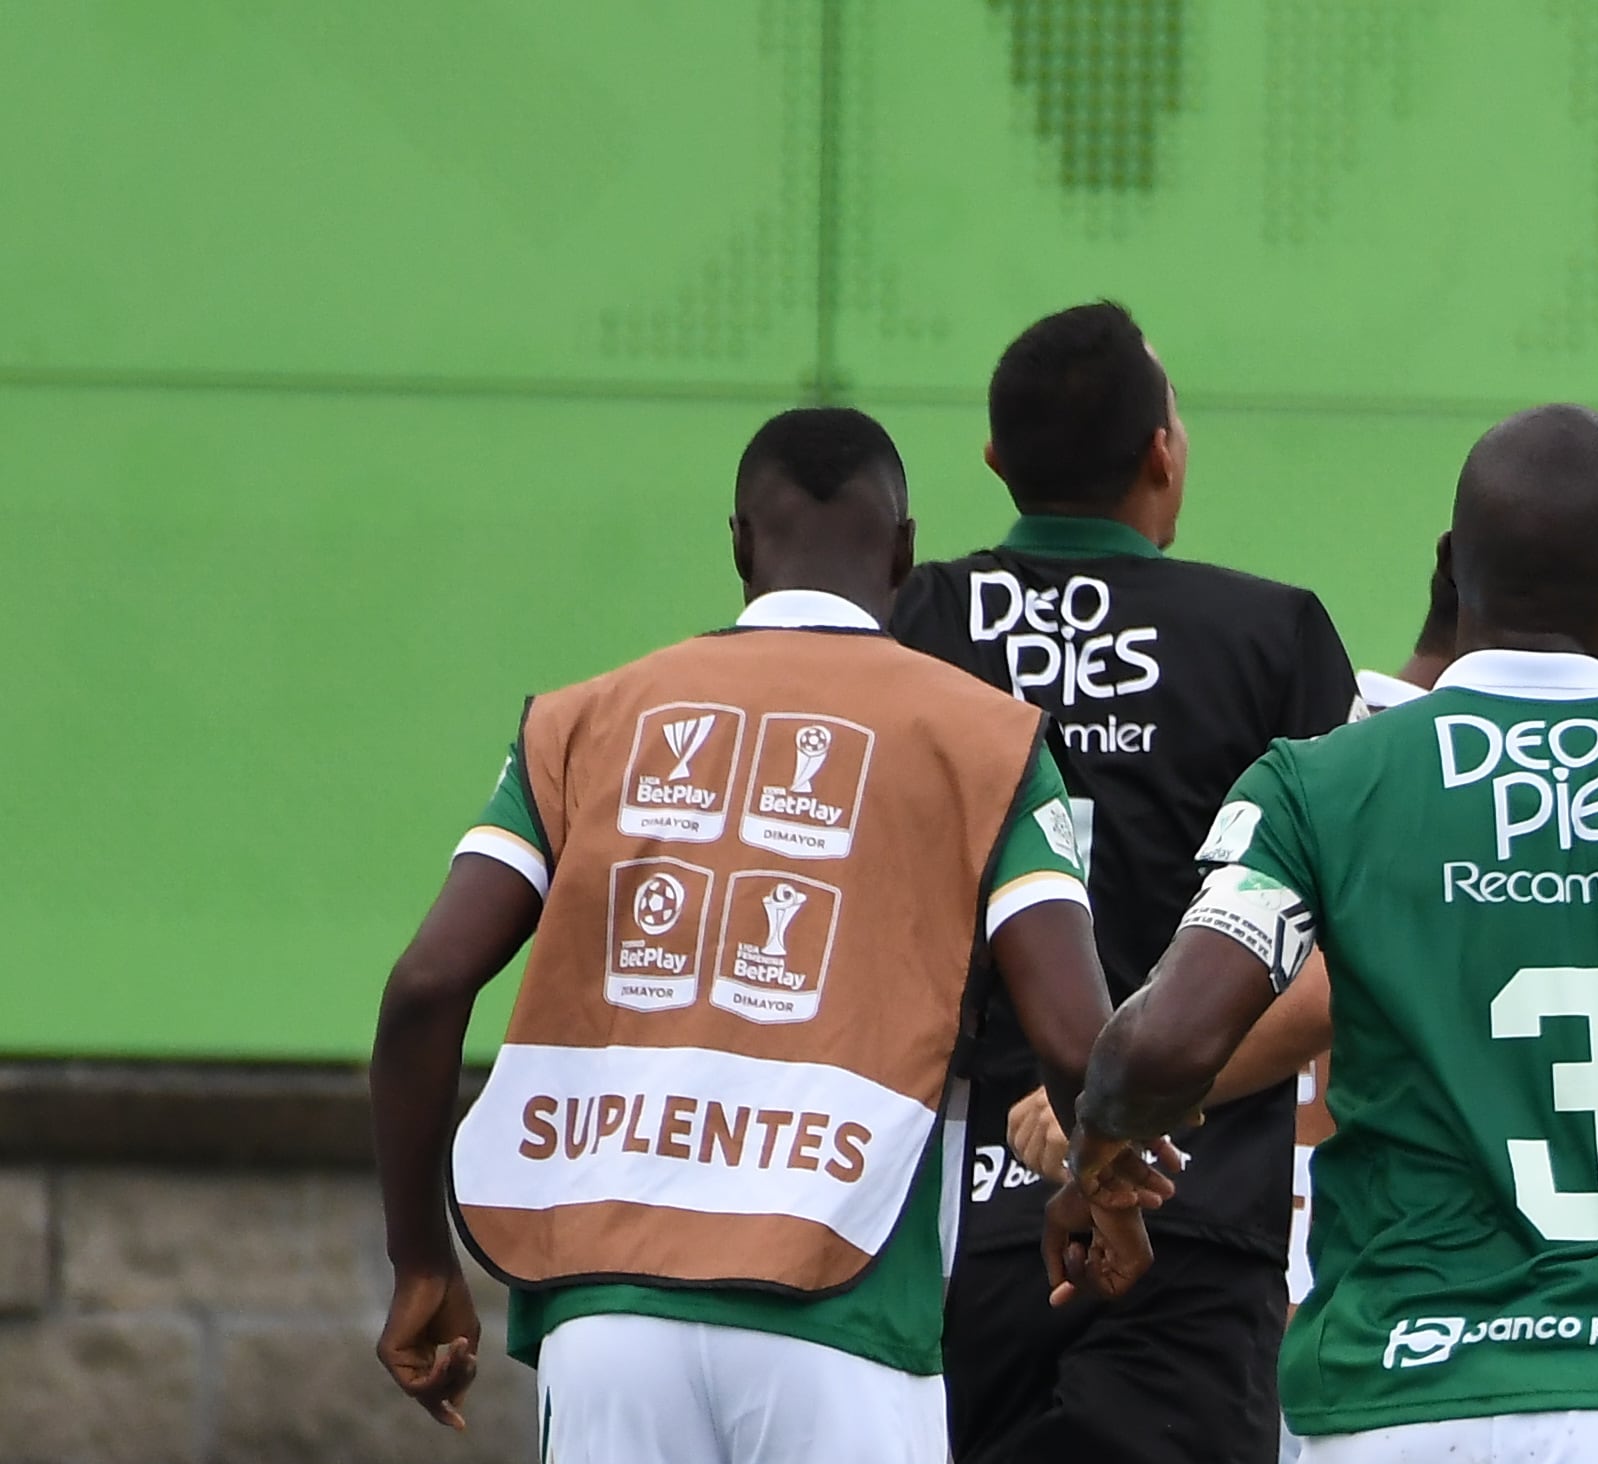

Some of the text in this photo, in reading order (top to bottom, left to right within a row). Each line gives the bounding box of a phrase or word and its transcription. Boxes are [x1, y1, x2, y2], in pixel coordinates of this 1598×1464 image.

[1059, 714, 1157, 753] mier
[637, 783, 717, 808] BetPlay
[759, 793, 843, 826] BetPlay
[763, 828, 826, 849] DIMAYOR
[619, 946, 687, 974] BetPlay
[733, 958, 806, 990] BetPlay
[732, 993, 795, 1013] DIMAYOR
[518, 1093, 873, 1184] SUPLENTES
